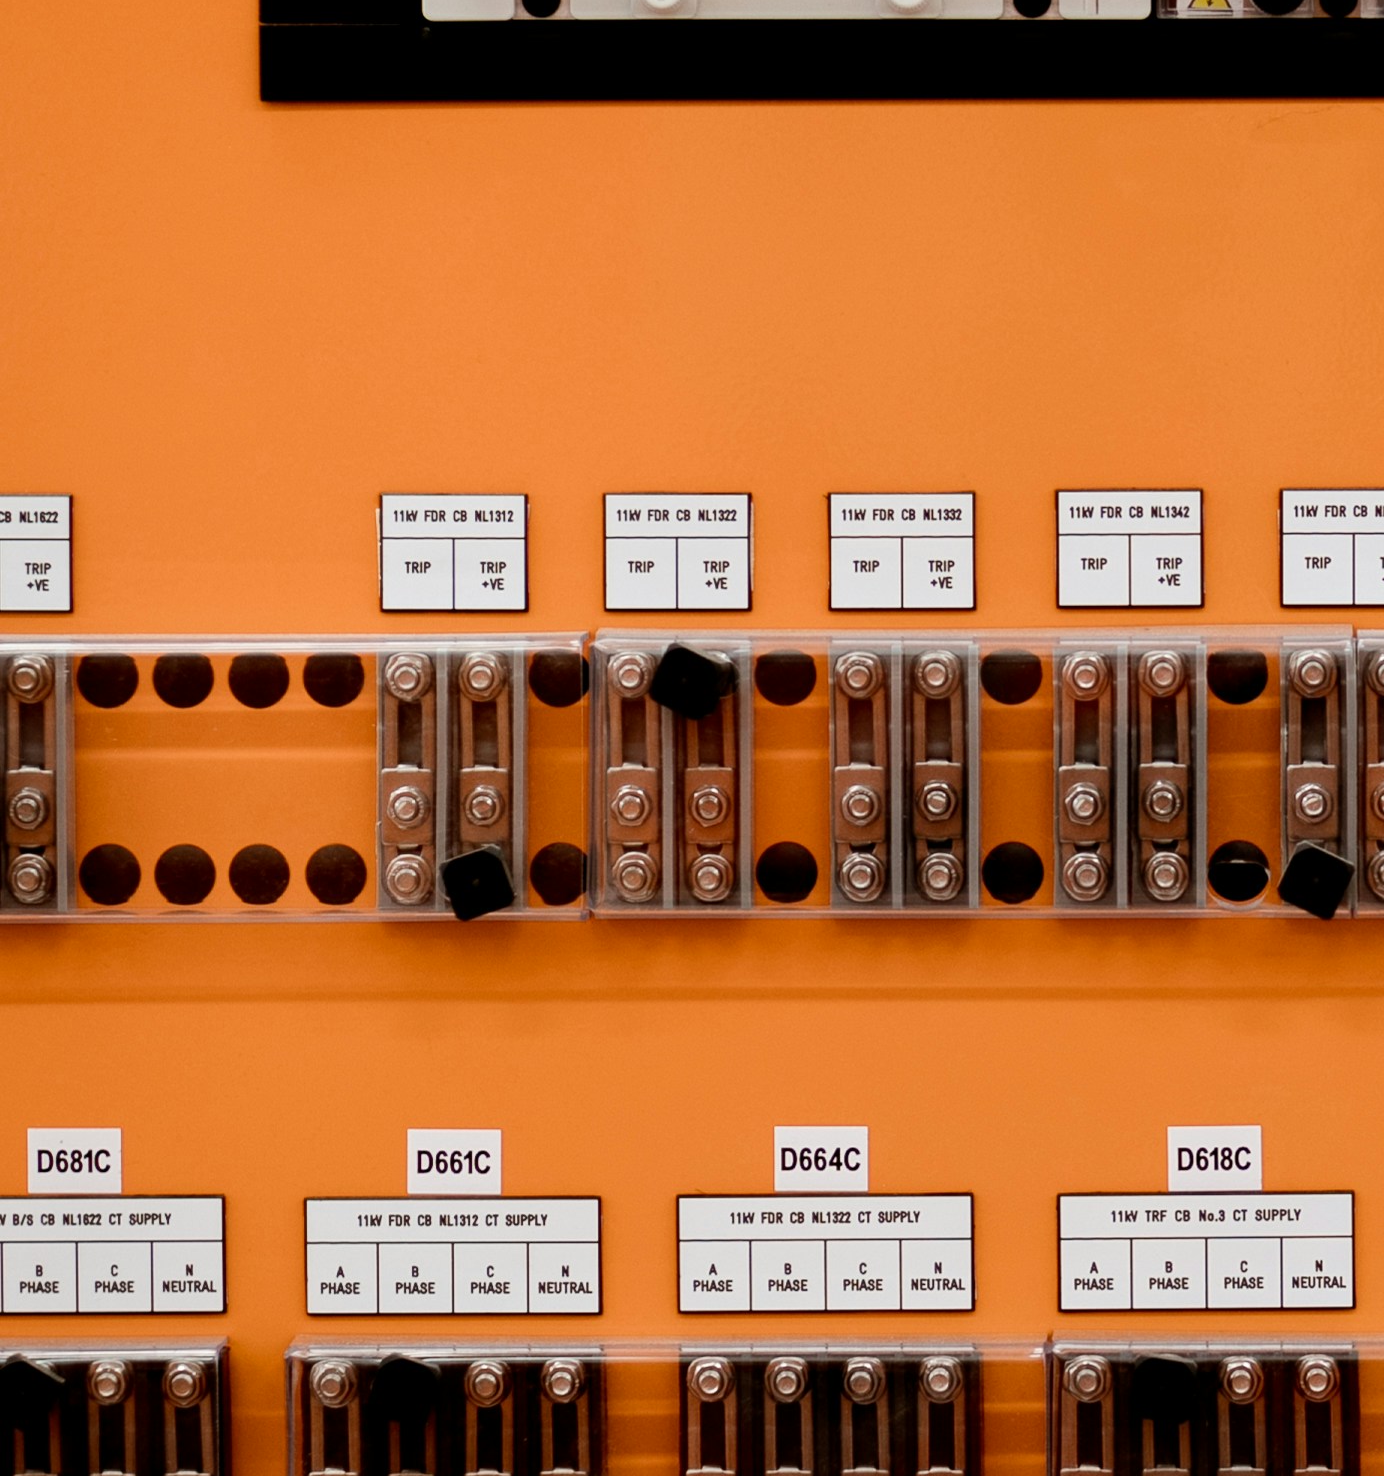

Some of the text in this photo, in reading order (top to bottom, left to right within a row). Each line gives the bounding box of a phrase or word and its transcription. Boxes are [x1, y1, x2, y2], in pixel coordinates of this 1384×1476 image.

[393, 509, 514, 523] 11kV FDR CB NL1312
[841, 508, 963, 522] 11kV FDR CB NL1332
[404, 561, 432, 574] TRIP
[479, 561, 507, 574] TRIP
[481, 577, 505, 591] +VE
[37, 1148, 111, 1174] D681C
[417, 1149, 491, 1175] D661C
[780, 1146, 861, 1172] D664C
[1177, 1146, 1252, 1172] D618C
[1111, 1208, 1302, 1223] 11kV TRF CB No.3 CT SUPPLY
